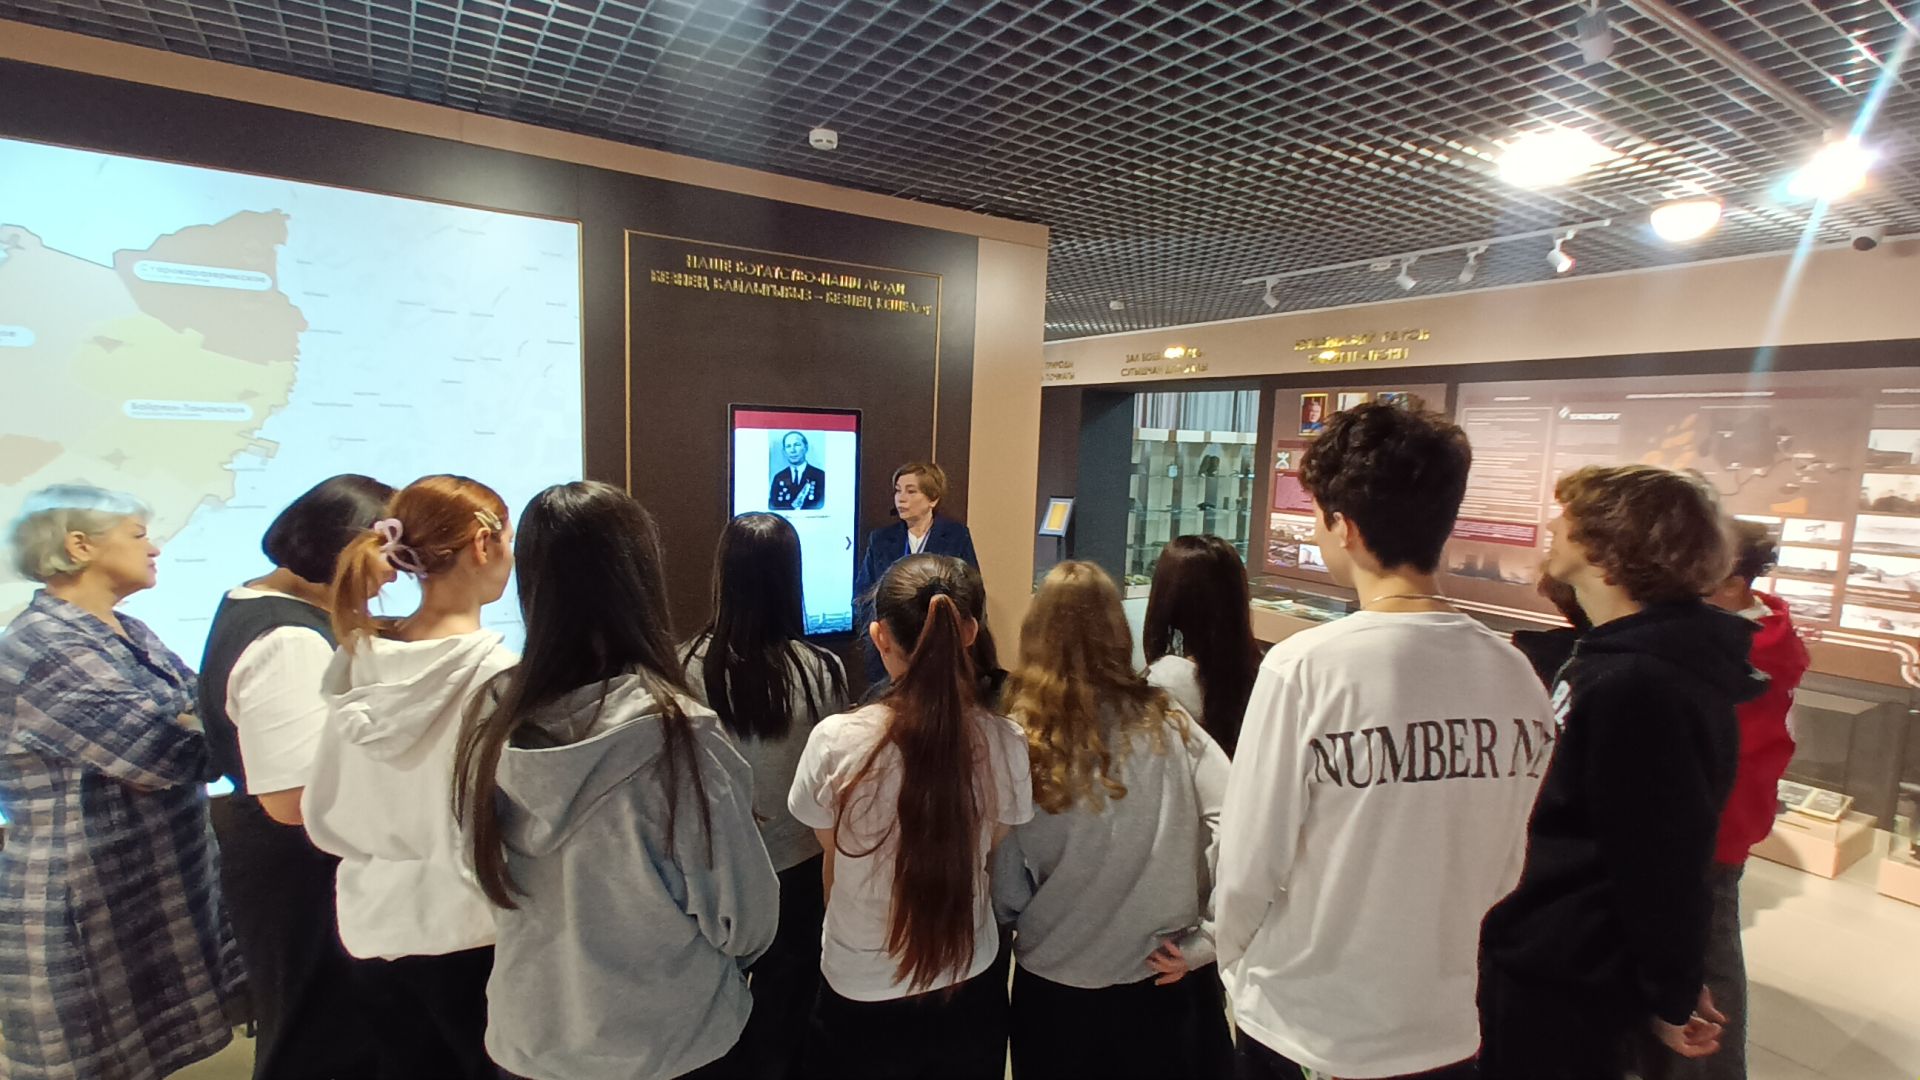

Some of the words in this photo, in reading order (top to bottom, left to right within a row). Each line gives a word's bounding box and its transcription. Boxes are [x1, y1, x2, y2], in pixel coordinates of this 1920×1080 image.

[686, 254, 732, 273] НАШЕ
[864, 279, 906, 296] ЛЮДИ
[1308, 717, 1500, 789] NUMBER
